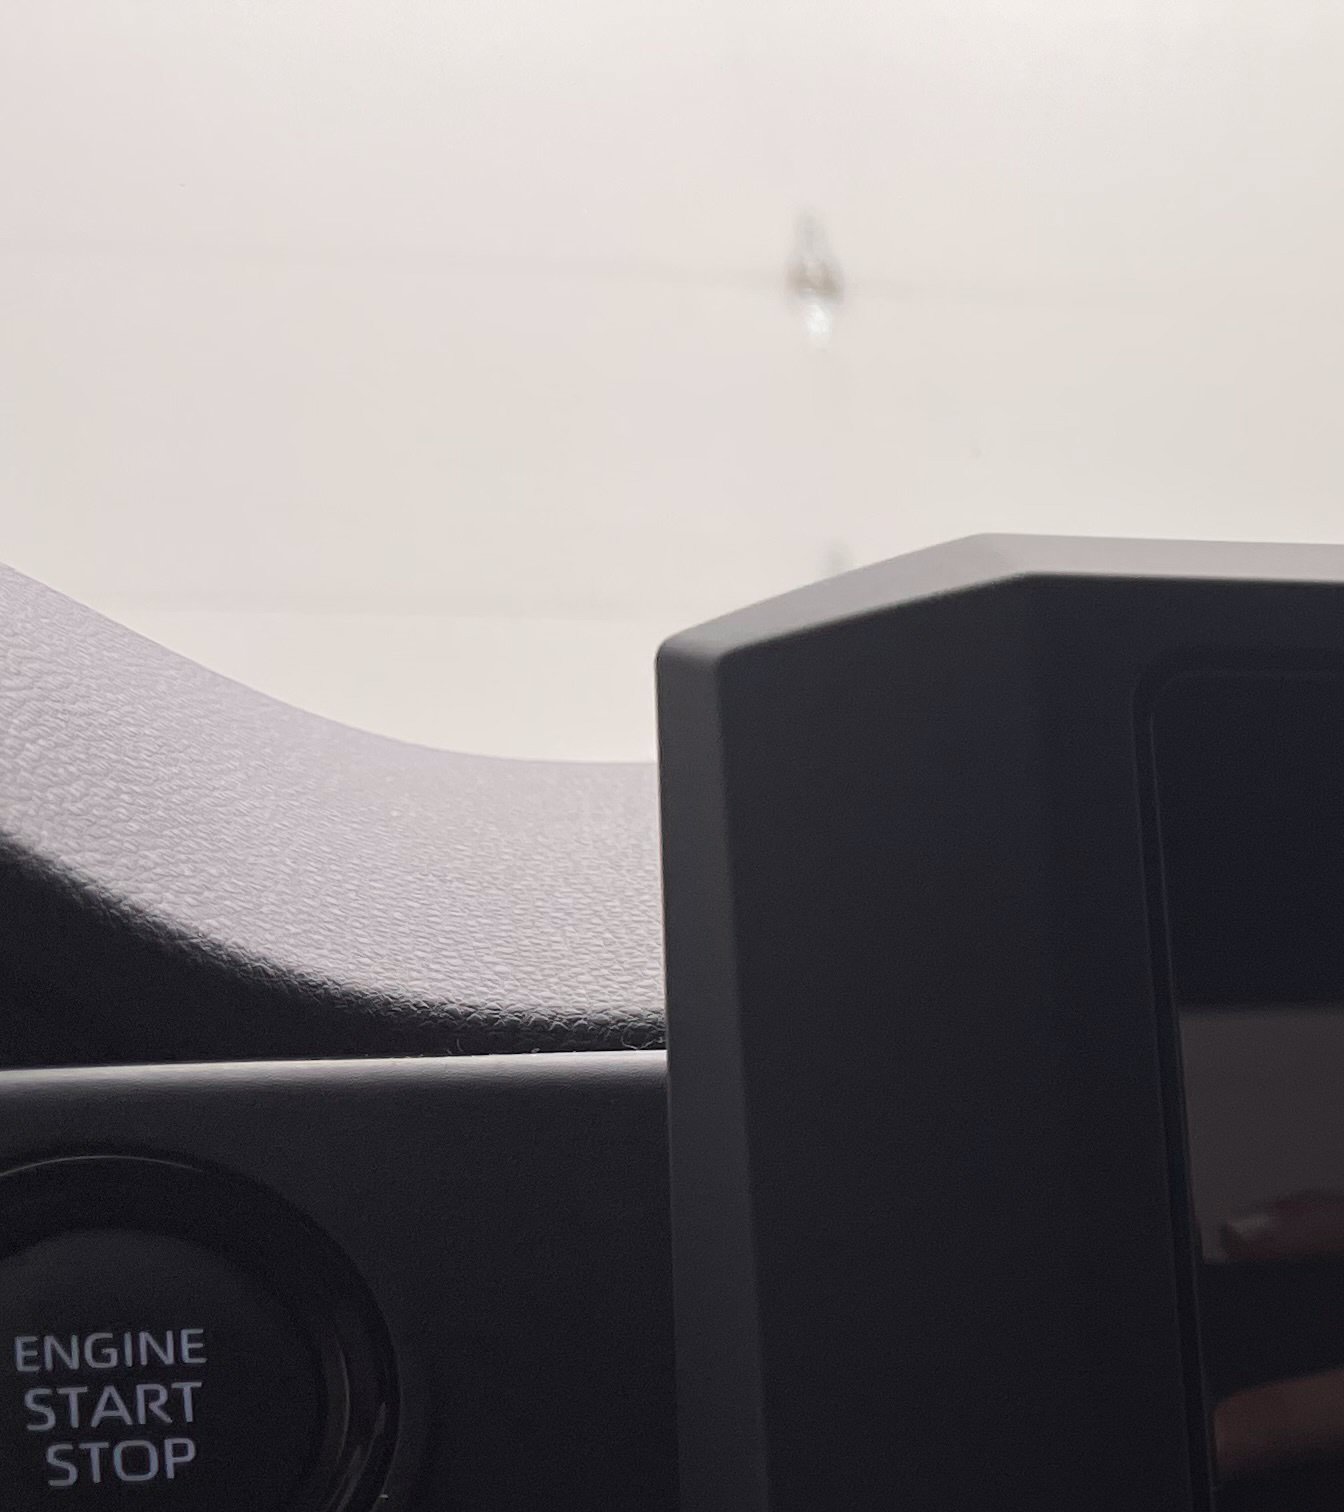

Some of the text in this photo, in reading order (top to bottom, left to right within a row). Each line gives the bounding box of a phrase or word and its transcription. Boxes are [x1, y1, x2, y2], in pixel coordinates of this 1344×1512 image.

[15, 1329, 208, 1372] ENGINE
[24, 1381, 202, 1431] START
[45, 1437, 196, 1487] STOP
